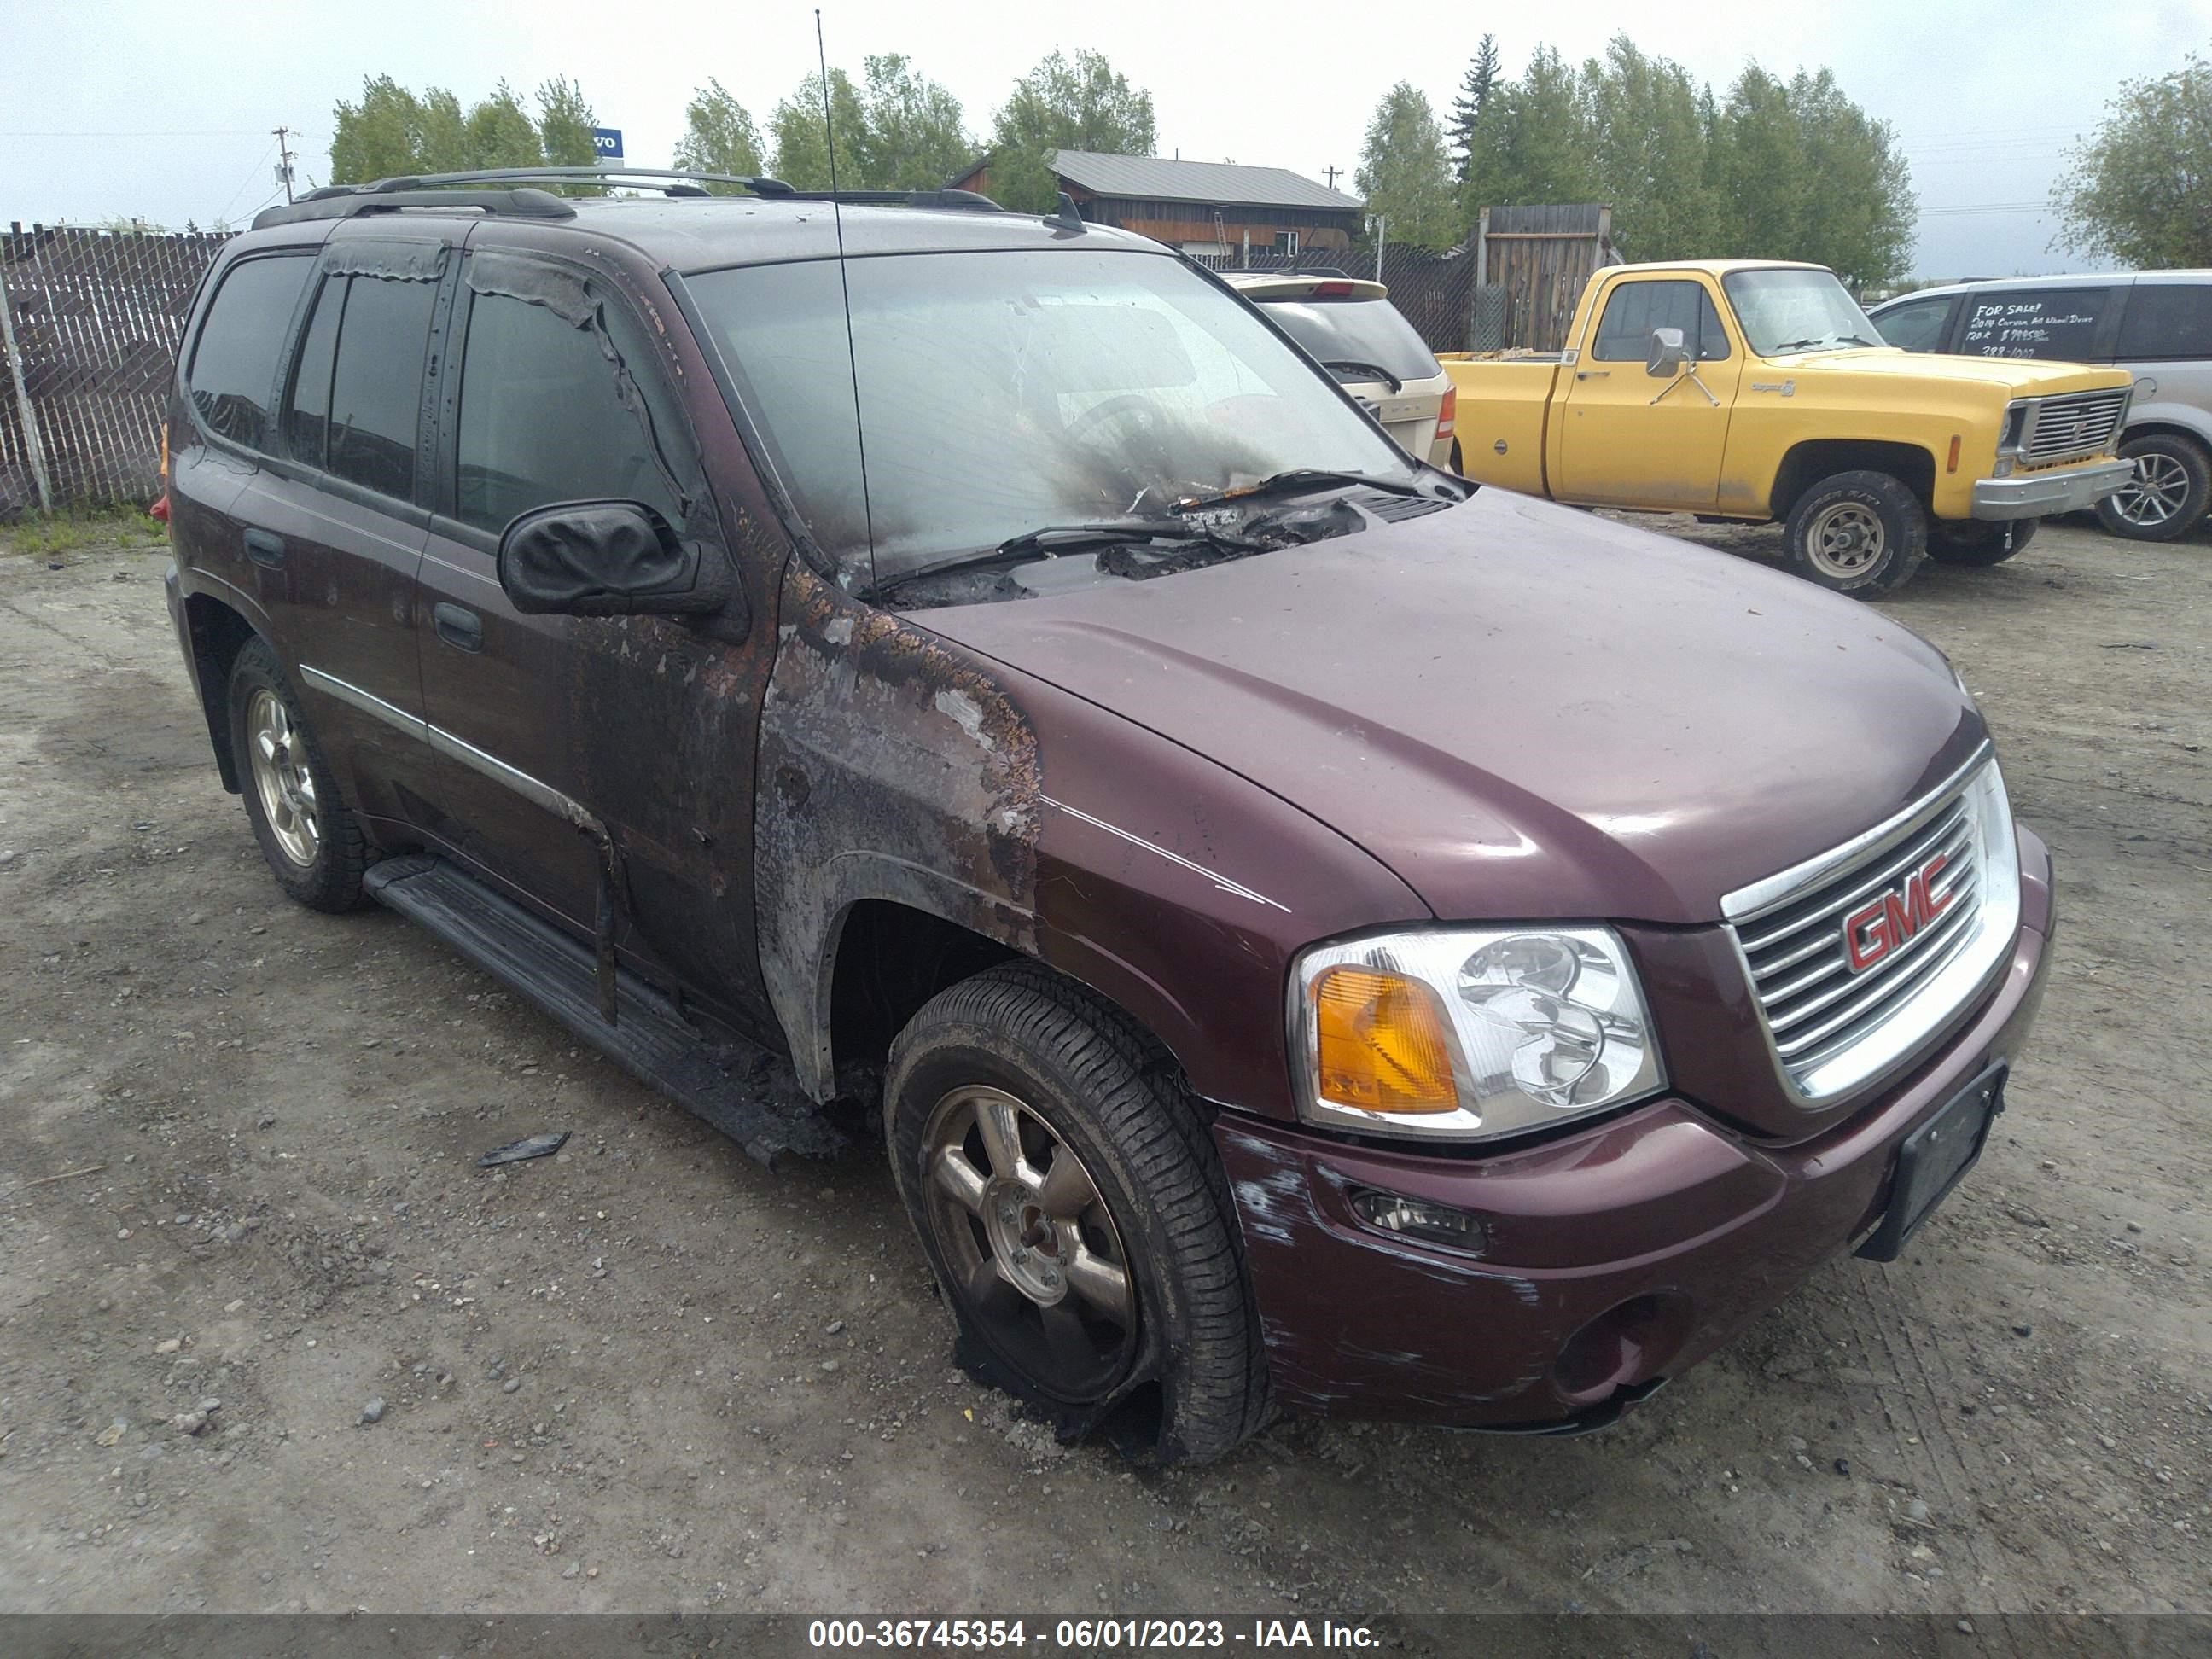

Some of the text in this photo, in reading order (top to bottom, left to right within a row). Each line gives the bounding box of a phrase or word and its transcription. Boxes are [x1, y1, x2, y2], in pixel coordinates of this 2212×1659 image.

[1976, 305, 2004, 317] FOR
[1970, 317, 1994, 329] 2014
[1843, 850, 1953, 975] GMC
